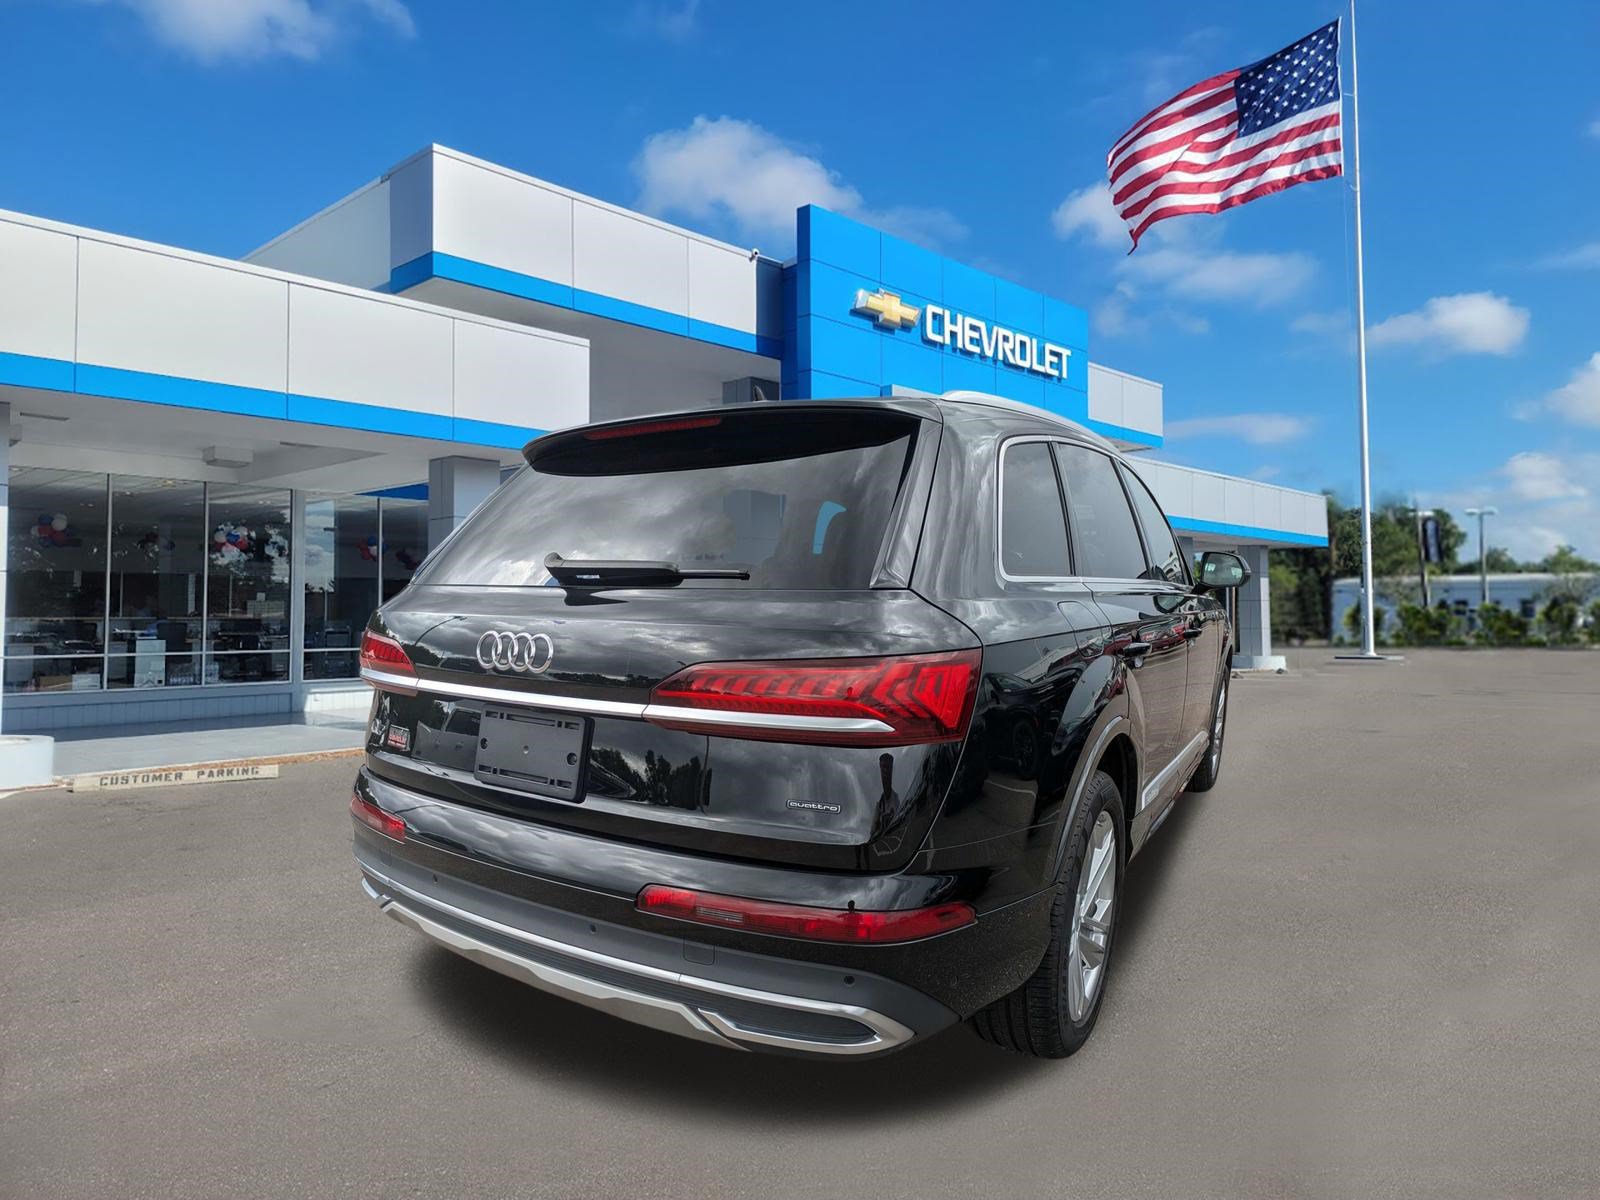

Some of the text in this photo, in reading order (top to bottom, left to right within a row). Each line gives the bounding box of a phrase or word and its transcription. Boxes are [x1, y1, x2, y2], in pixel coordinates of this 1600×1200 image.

[925, 304, 1072, 379] CHEVROLET
[99, 766, 260, 786] CUSTOMER PARKING
[789, 801, 838, 811] quattro
